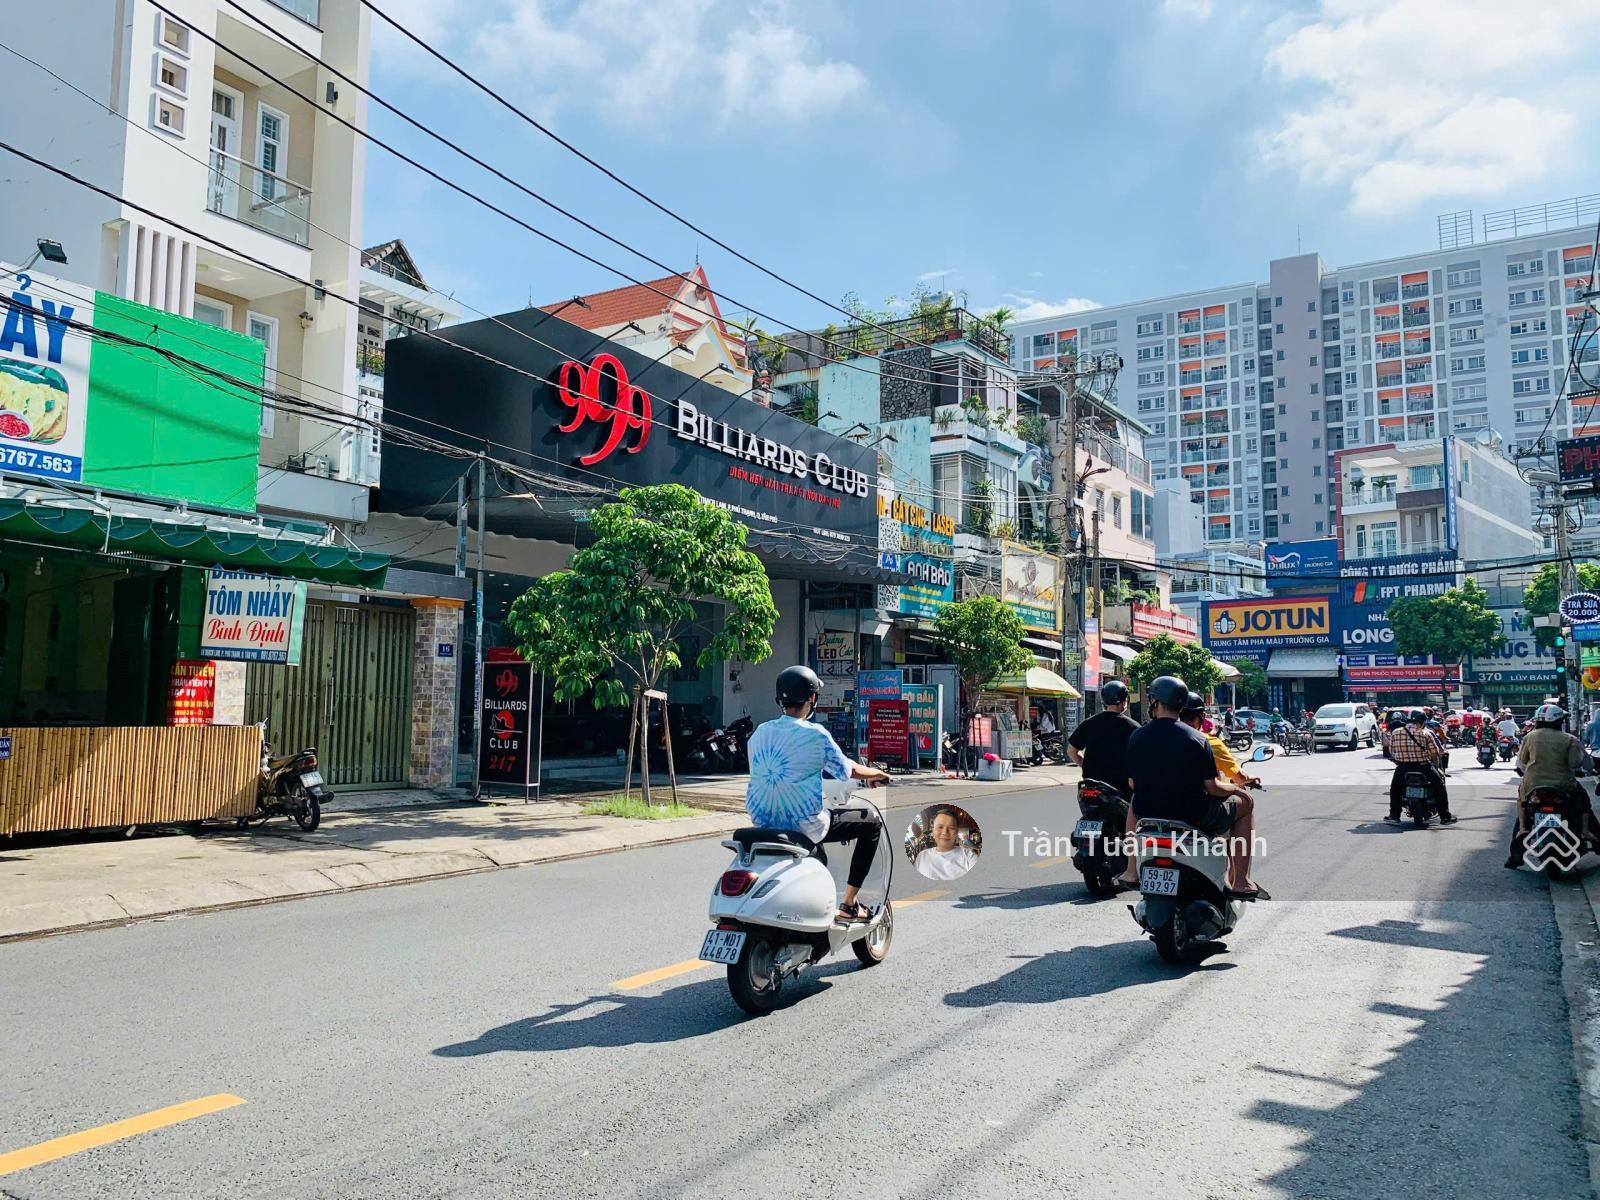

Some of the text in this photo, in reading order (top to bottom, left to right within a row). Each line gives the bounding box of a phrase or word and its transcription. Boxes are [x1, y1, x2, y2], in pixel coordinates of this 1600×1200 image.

[559, 353, 652, 465] 999
[677, 400, 869, 498] BILLIARDS CLUB
[1381, 582, 1452, 598] FPT PHARMA
[208, 583, 292, 618] TÔM NHẢY
[1240, 607, 1325, 632] JOTUN
[207, 618, 285, 648] Bình Định
[1343, 628, 1395, 644] LONG
[1234, 638, 1249, 646] TÂM
[818, 649, 837, 660] LED
[496, 669, 518, 696] 999
[1478, 672, 1502, 681] 370
[484, 699, 527, 711] BILLIARDS
[489, 737, 519, 749] CLUB
[1143, 881, 1176, 893] 992.97
[707, 930, 742, 947] 41-MD1
[702, 947, 737, 961] 448.78
